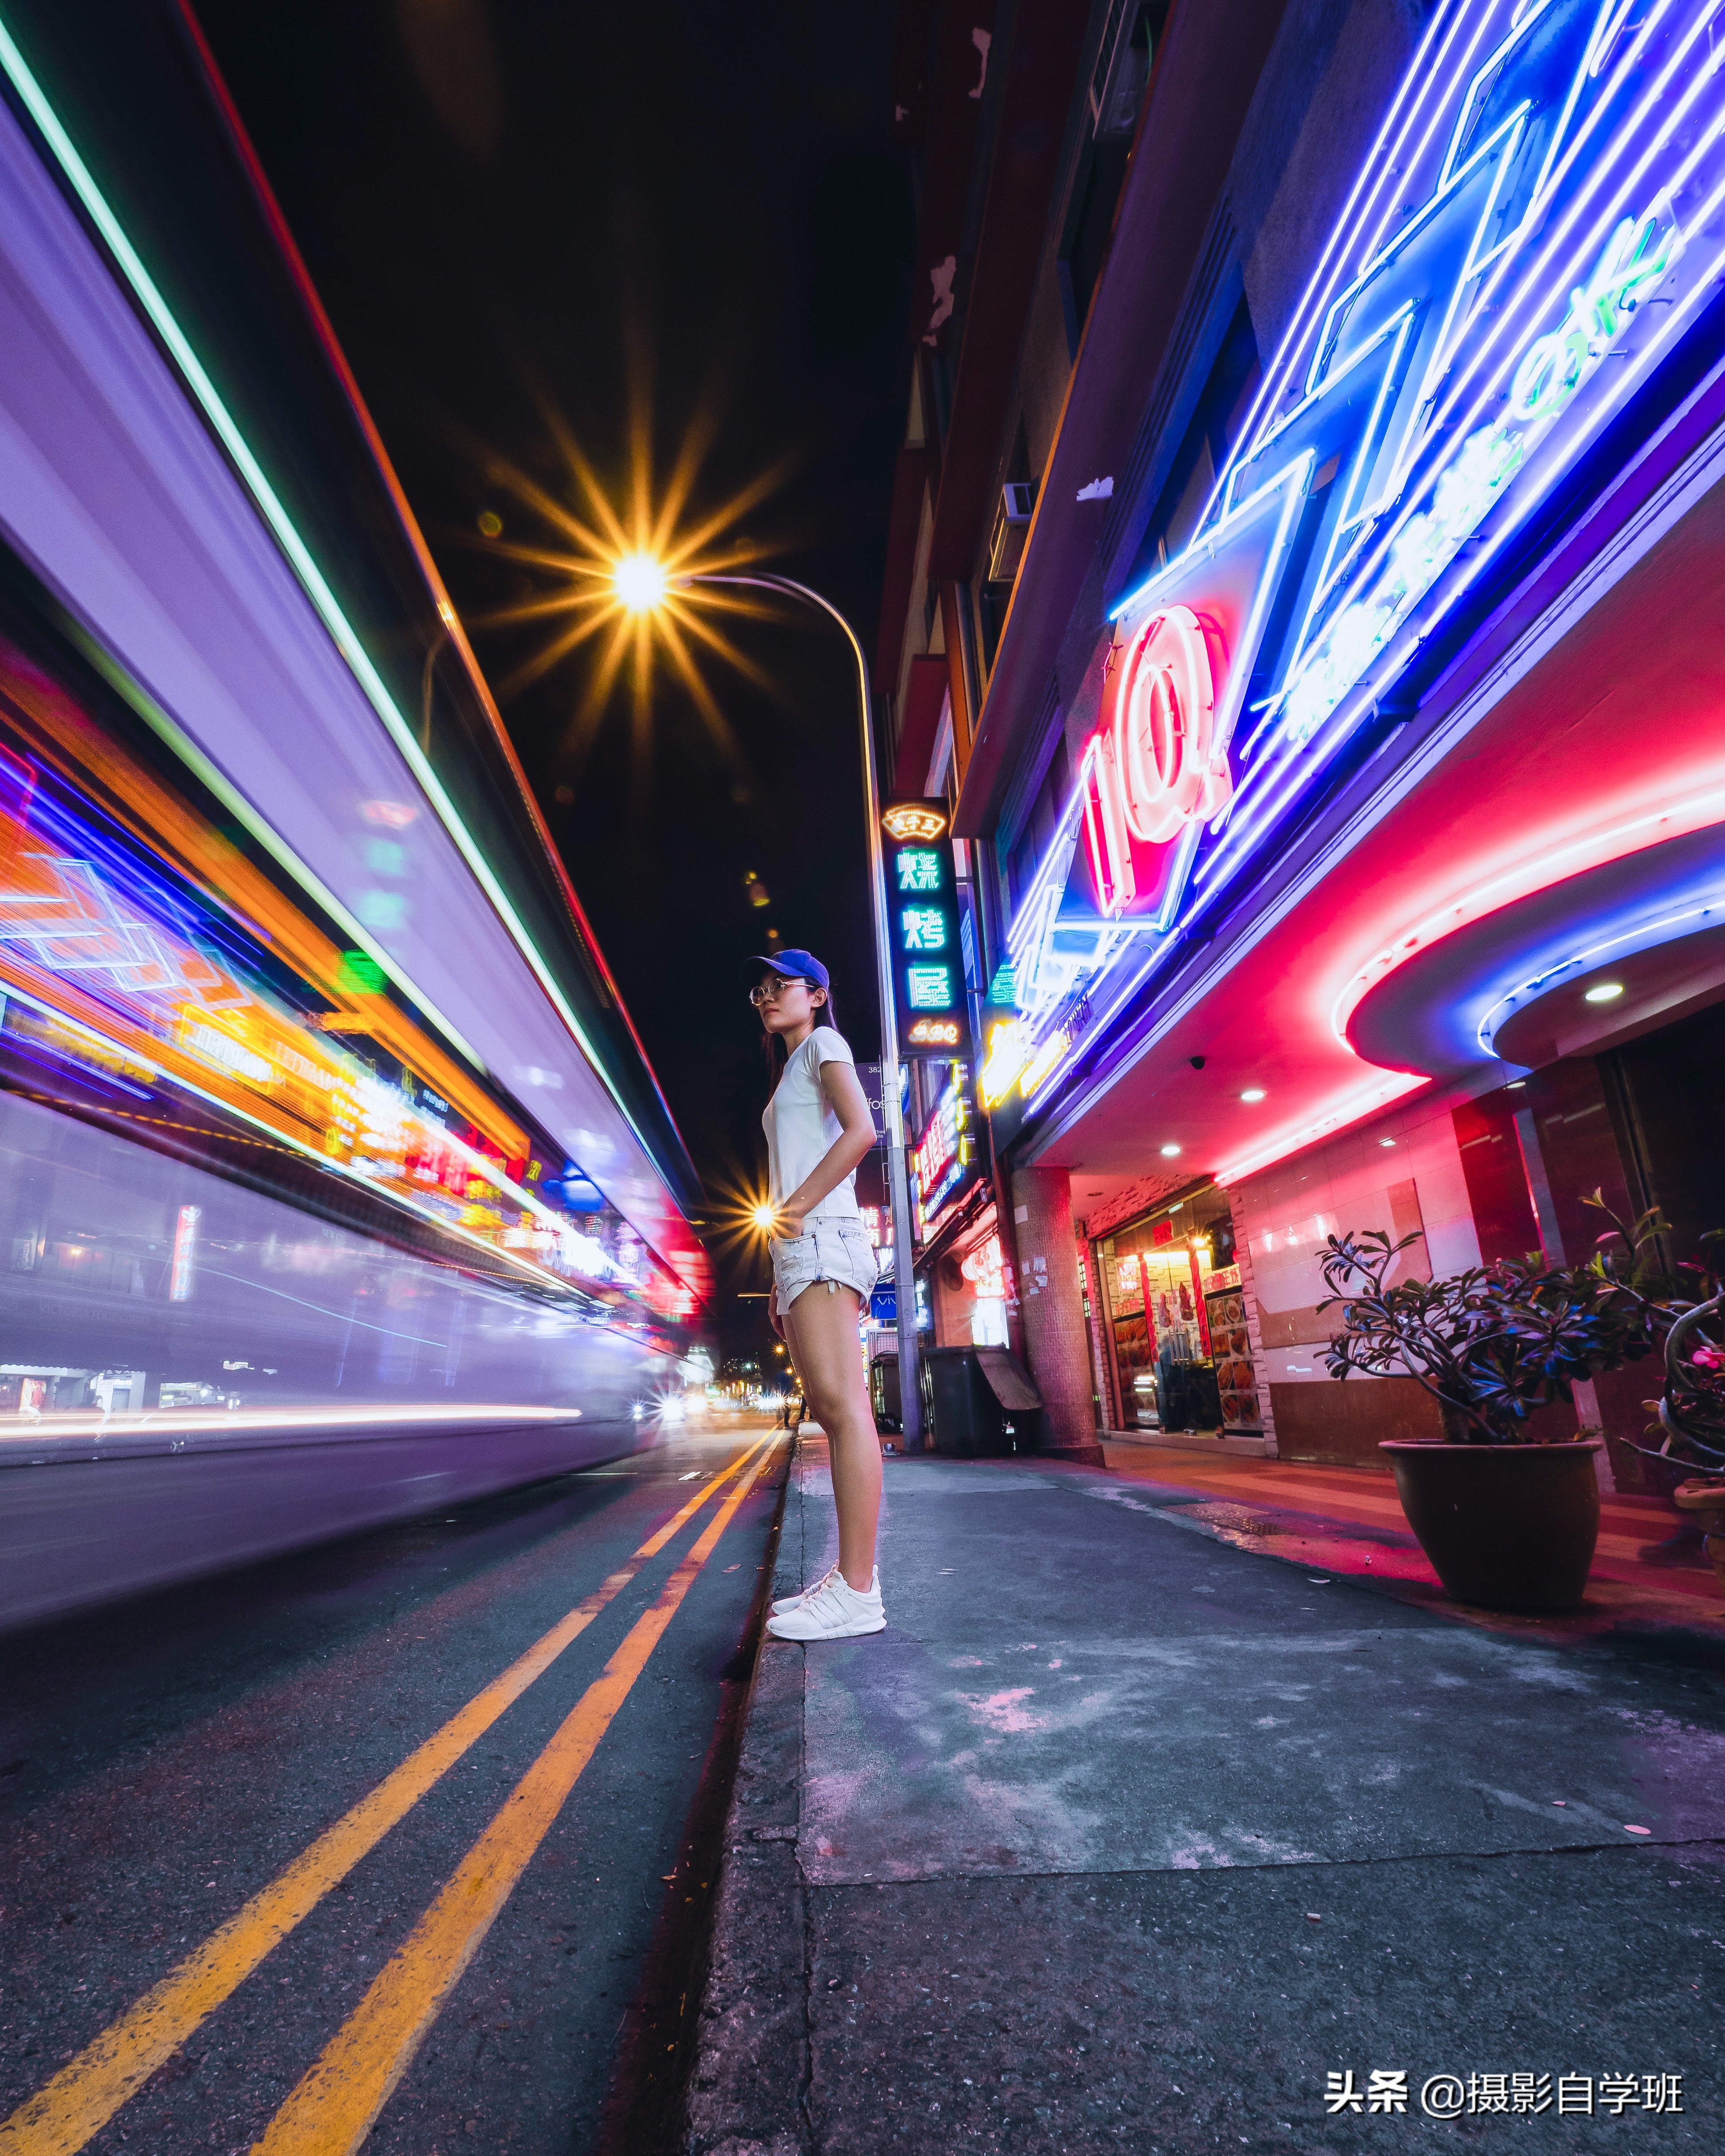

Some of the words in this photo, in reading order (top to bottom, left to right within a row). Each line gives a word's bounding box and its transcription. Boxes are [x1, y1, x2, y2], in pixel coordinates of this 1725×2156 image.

[897, 852, 951, 1007] 烧烤屋
[908, 1021, 957, 1043] BBQ
